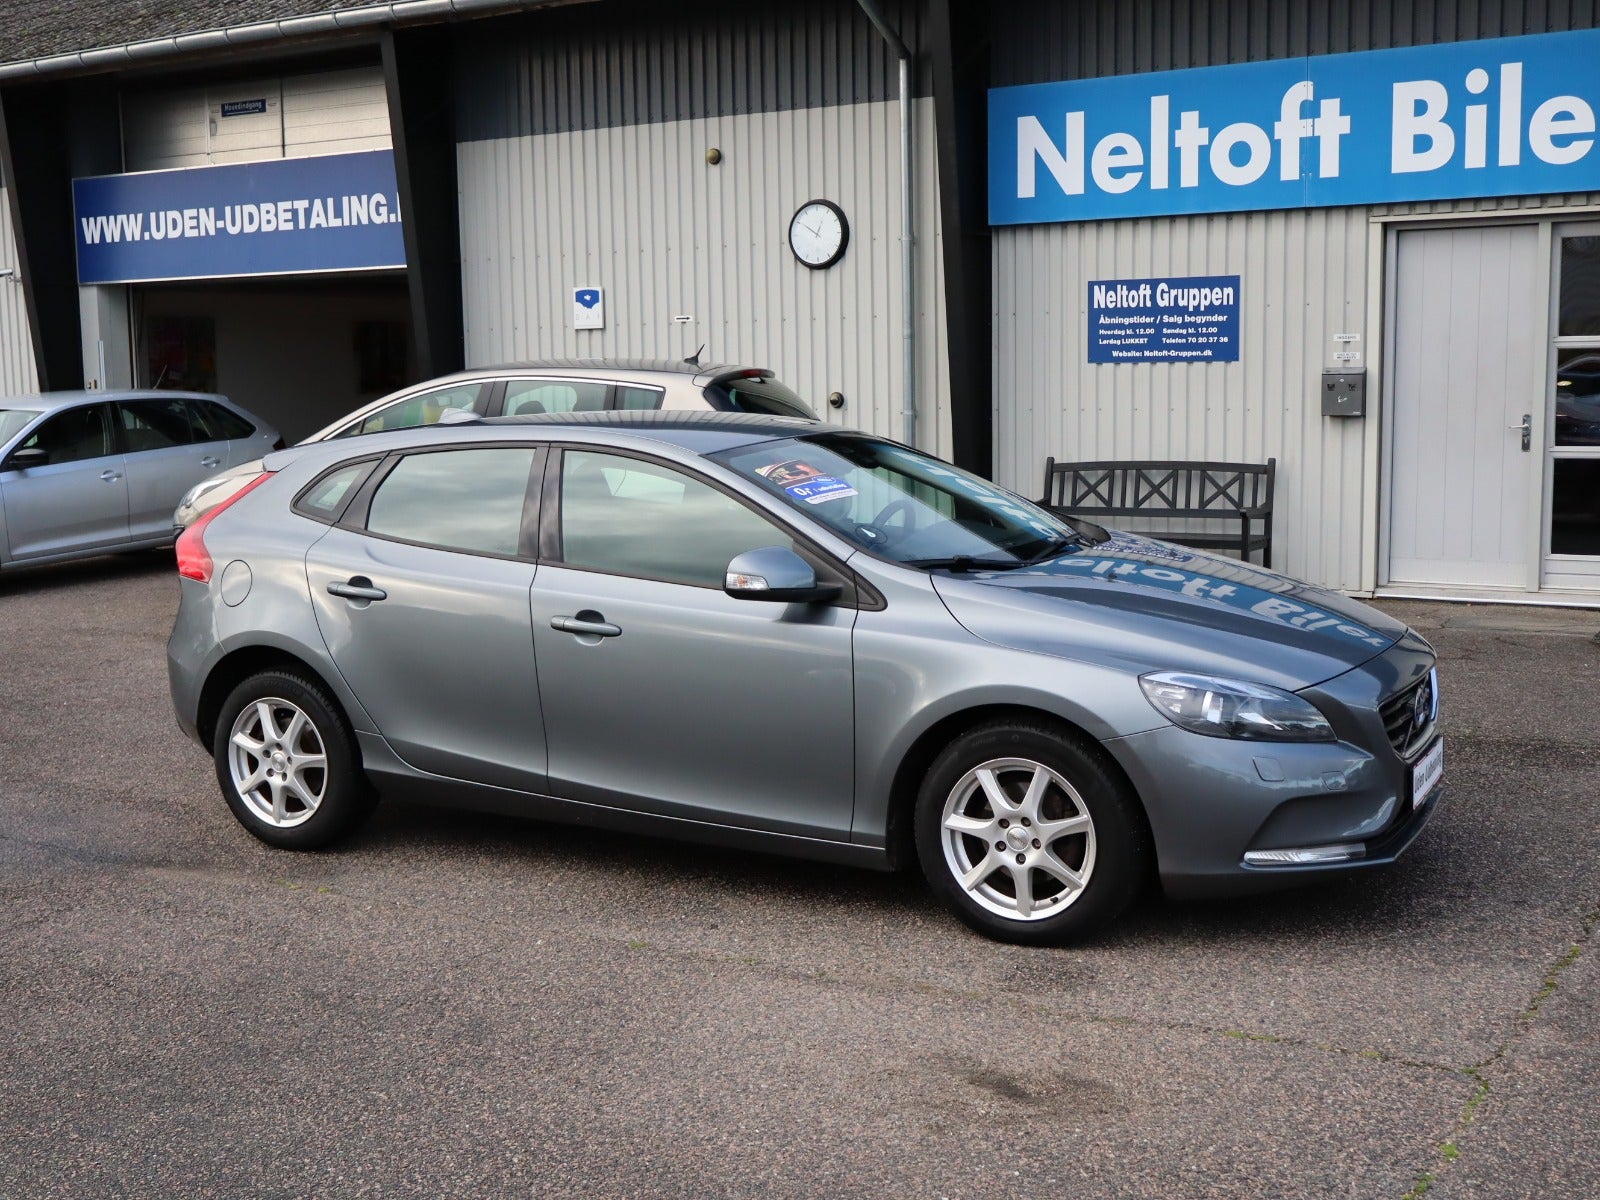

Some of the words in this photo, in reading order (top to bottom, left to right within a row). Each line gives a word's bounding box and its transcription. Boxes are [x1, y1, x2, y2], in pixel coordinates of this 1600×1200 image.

[1017, 81, 1350, 199] Neltoft
[81, 192, 401, 244] WWW.UDEN-UDBETALING.
[1093, 284, 1151, 309] Neltoft
[1156, 282, 1234, 312] Gruppen
[1099, 314, 1155, 325] Åbningstider
[1156, 315, 1161, 324] /
[1162, 314, 1182, 325] Salg
[1184, 313, 1228, 324] begynder
[1136, 327, 1155, 335] 12.00
[1198, 326, 1218, 334] 12.00
